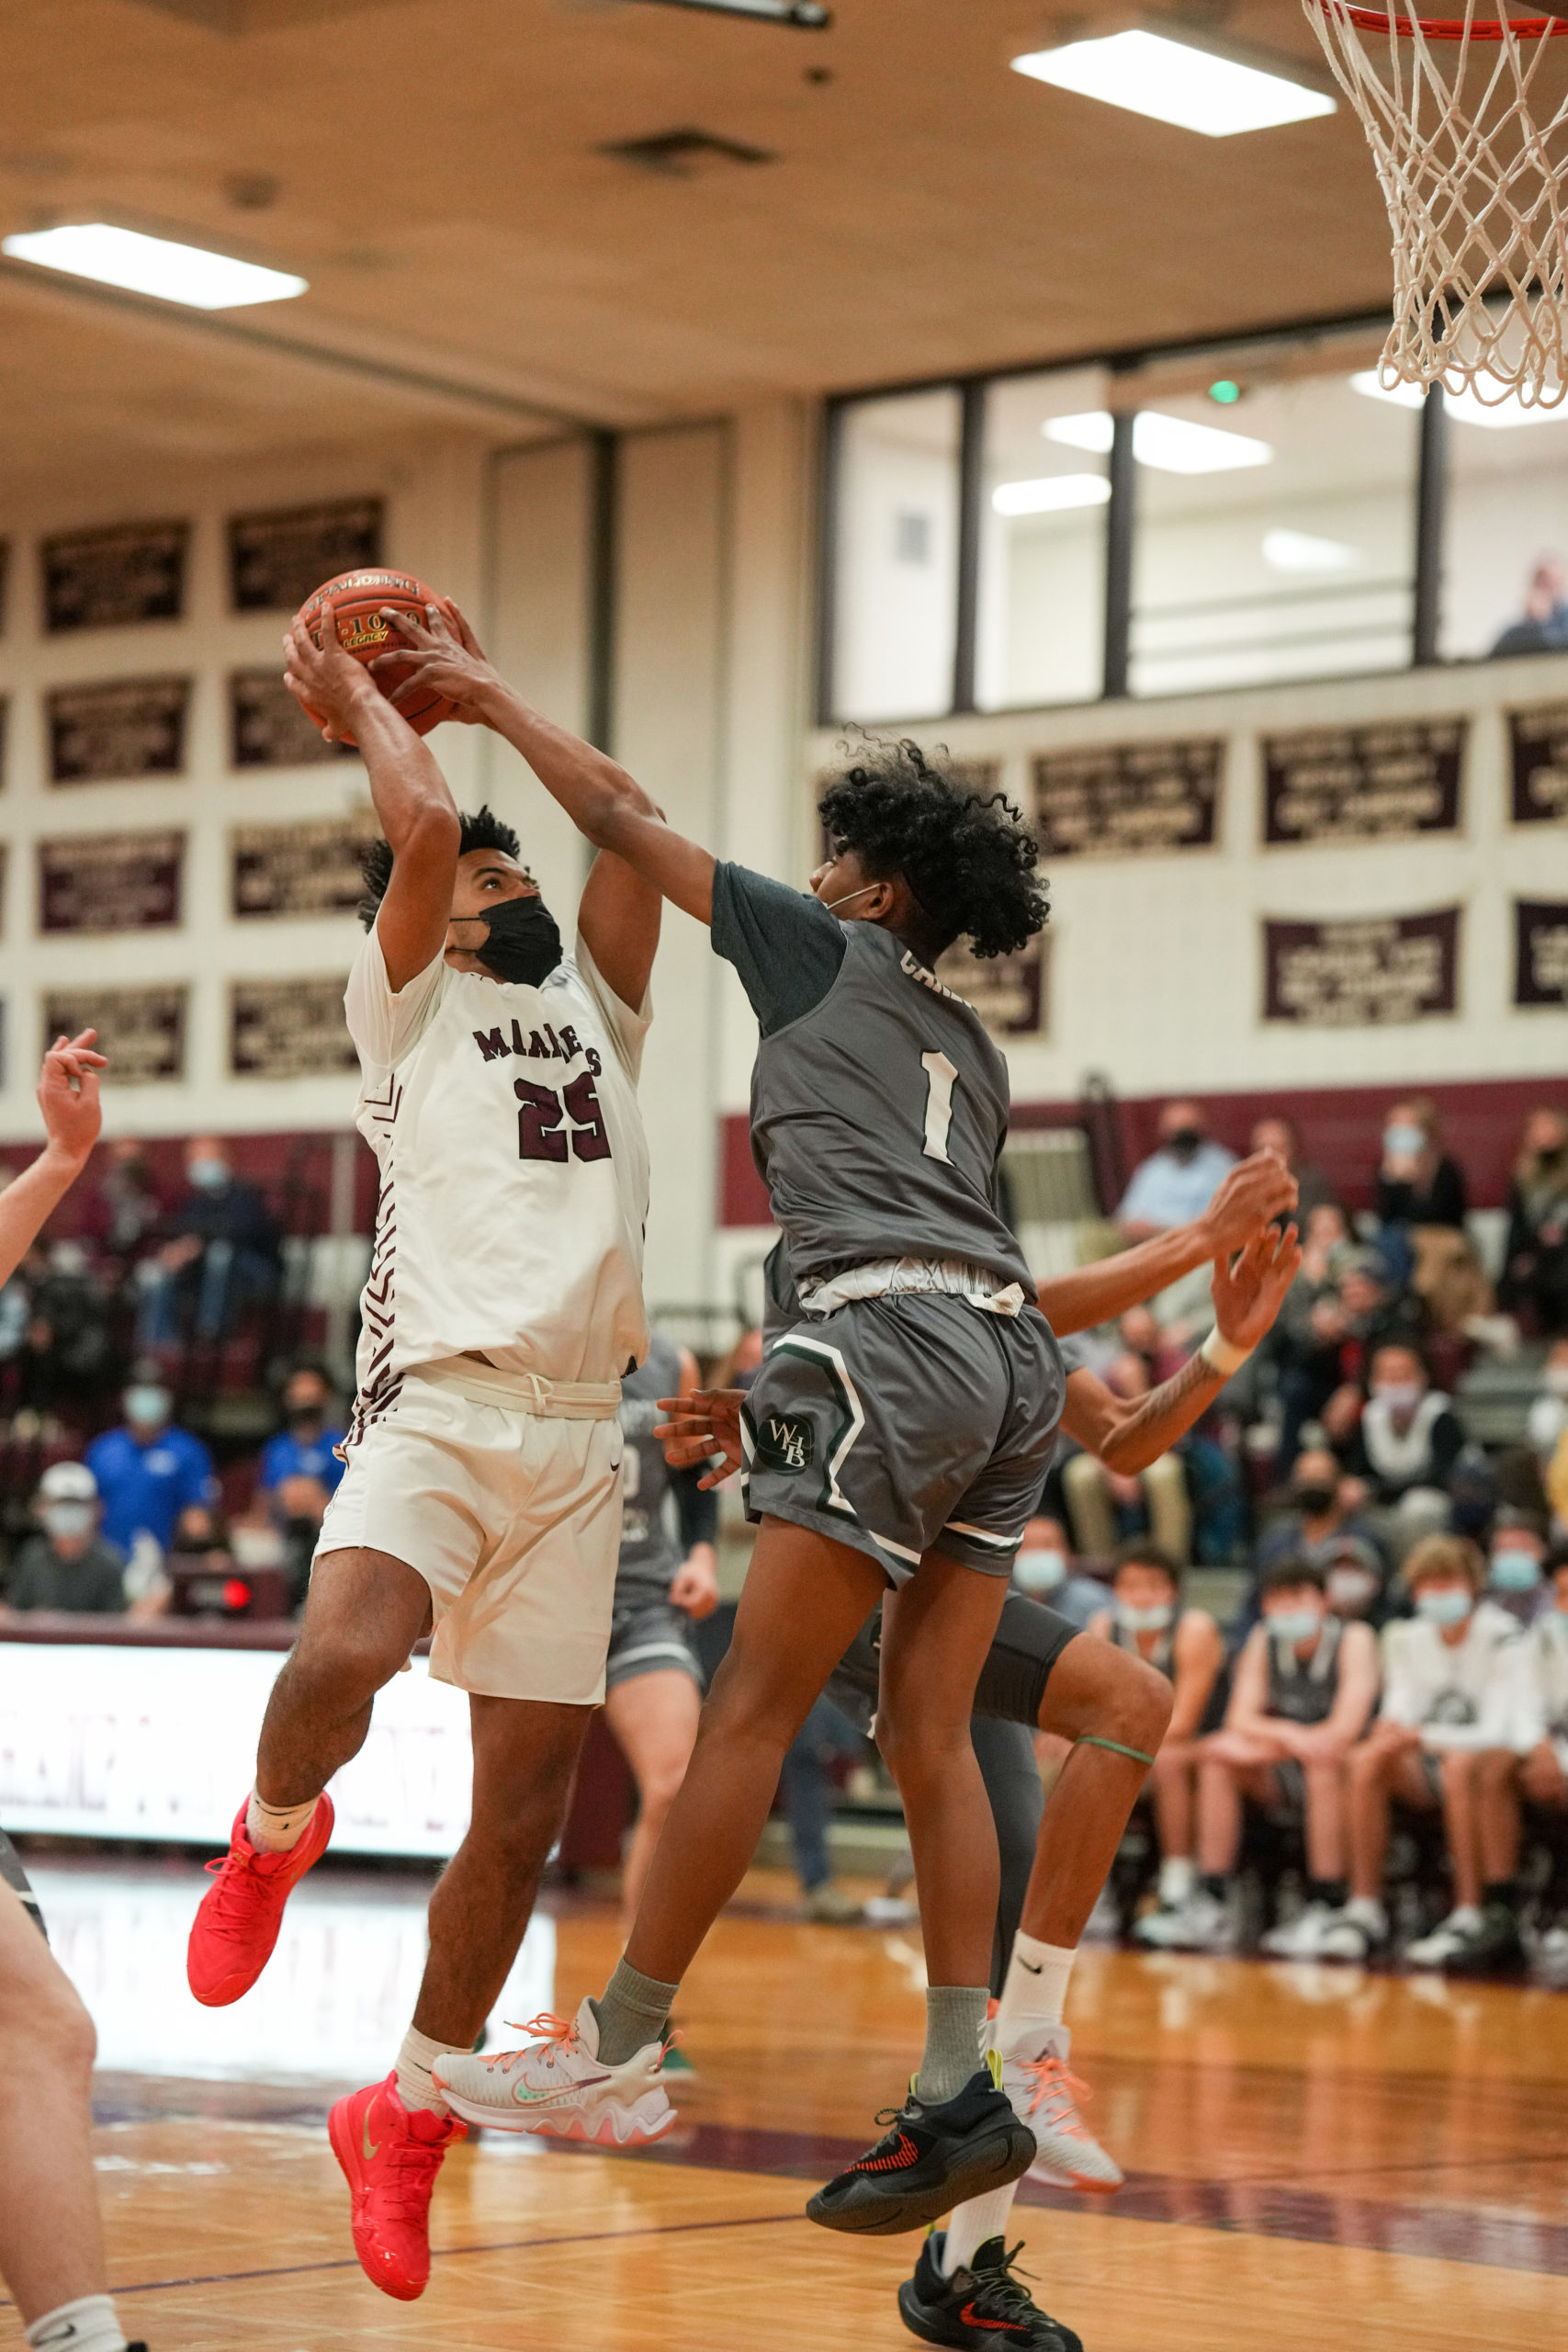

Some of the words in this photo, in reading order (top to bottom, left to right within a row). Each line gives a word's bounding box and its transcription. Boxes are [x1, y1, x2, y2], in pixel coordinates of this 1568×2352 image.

[344, 630, 389, 649] LEGACY
[513, 1071, 613, 1163] 25
[920, 1050, 959, 1166] 1
